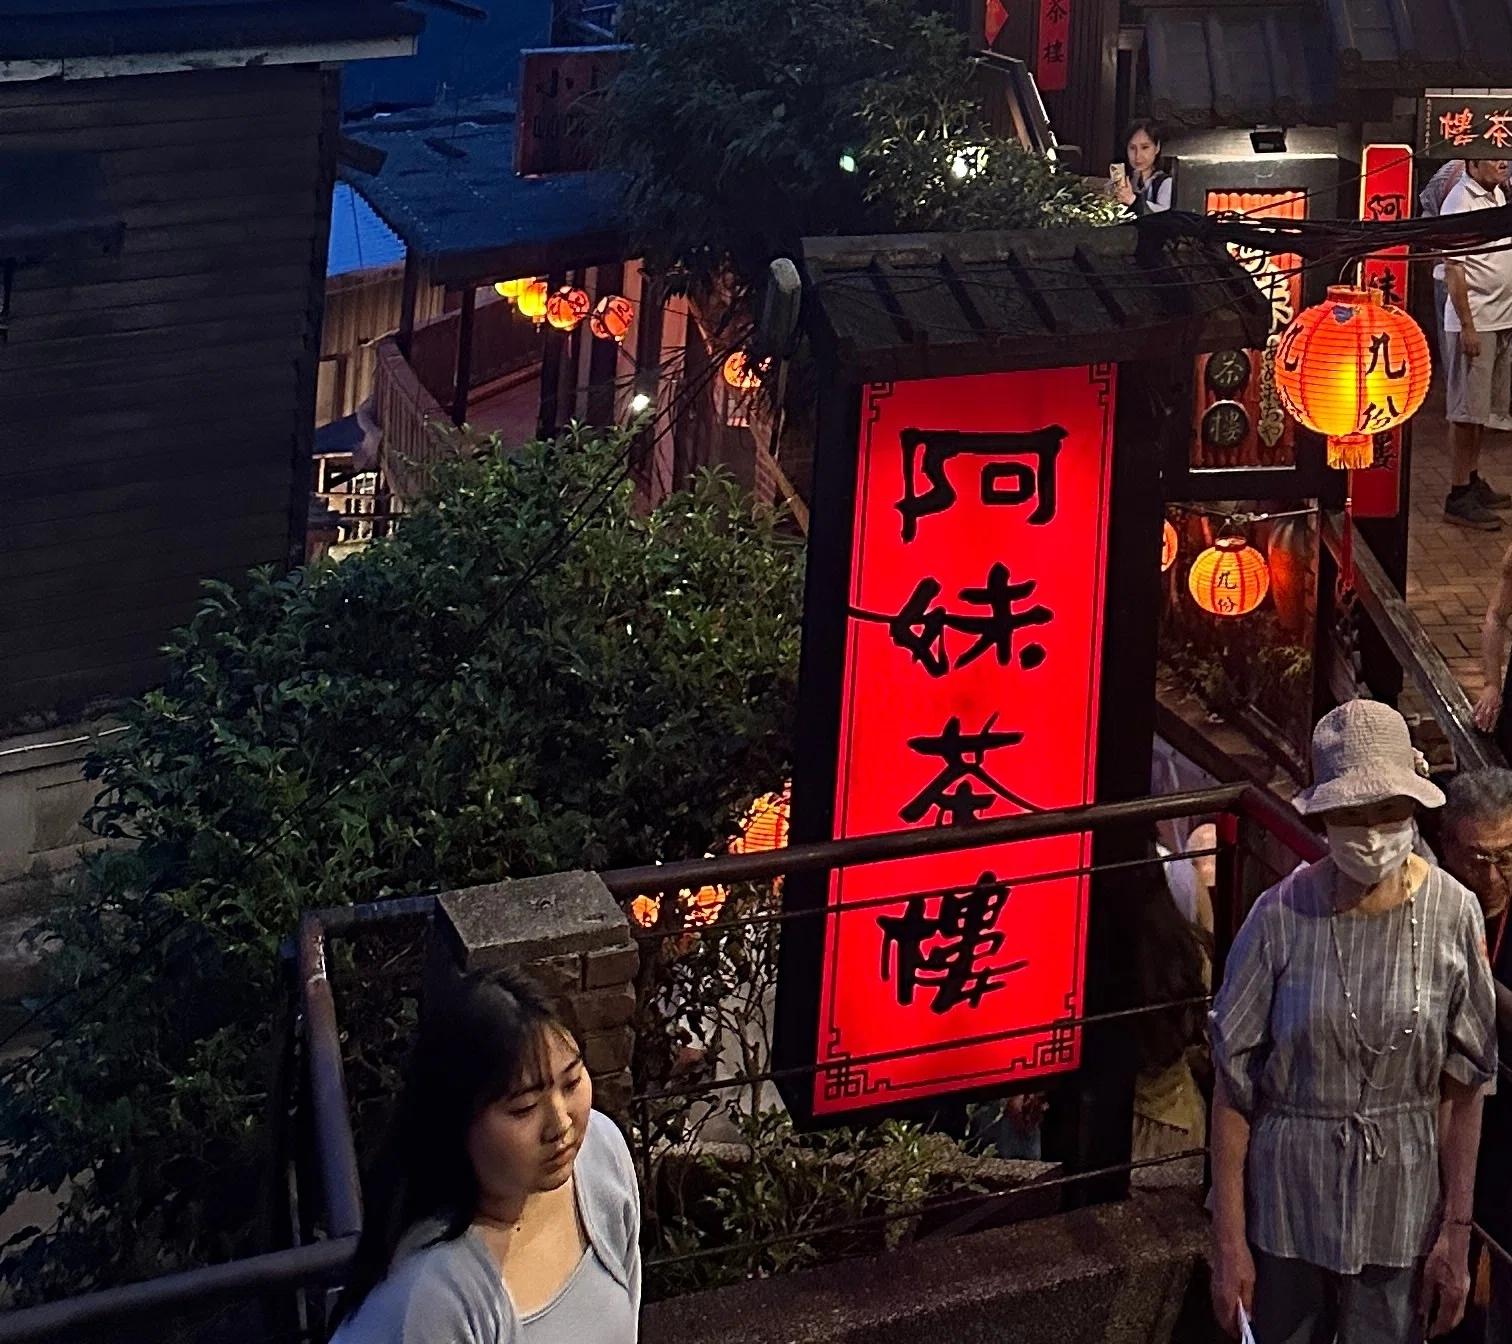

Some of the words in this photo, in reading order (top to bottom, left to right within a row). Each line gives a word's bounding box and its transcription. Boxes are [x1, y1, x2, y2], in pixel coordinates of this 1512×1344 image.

[1365, 332, 1406, 432] 九份
[1216, 570, 1238, 613] 九份
[860, 425, 1068, 1015] 阿妹茶樓
